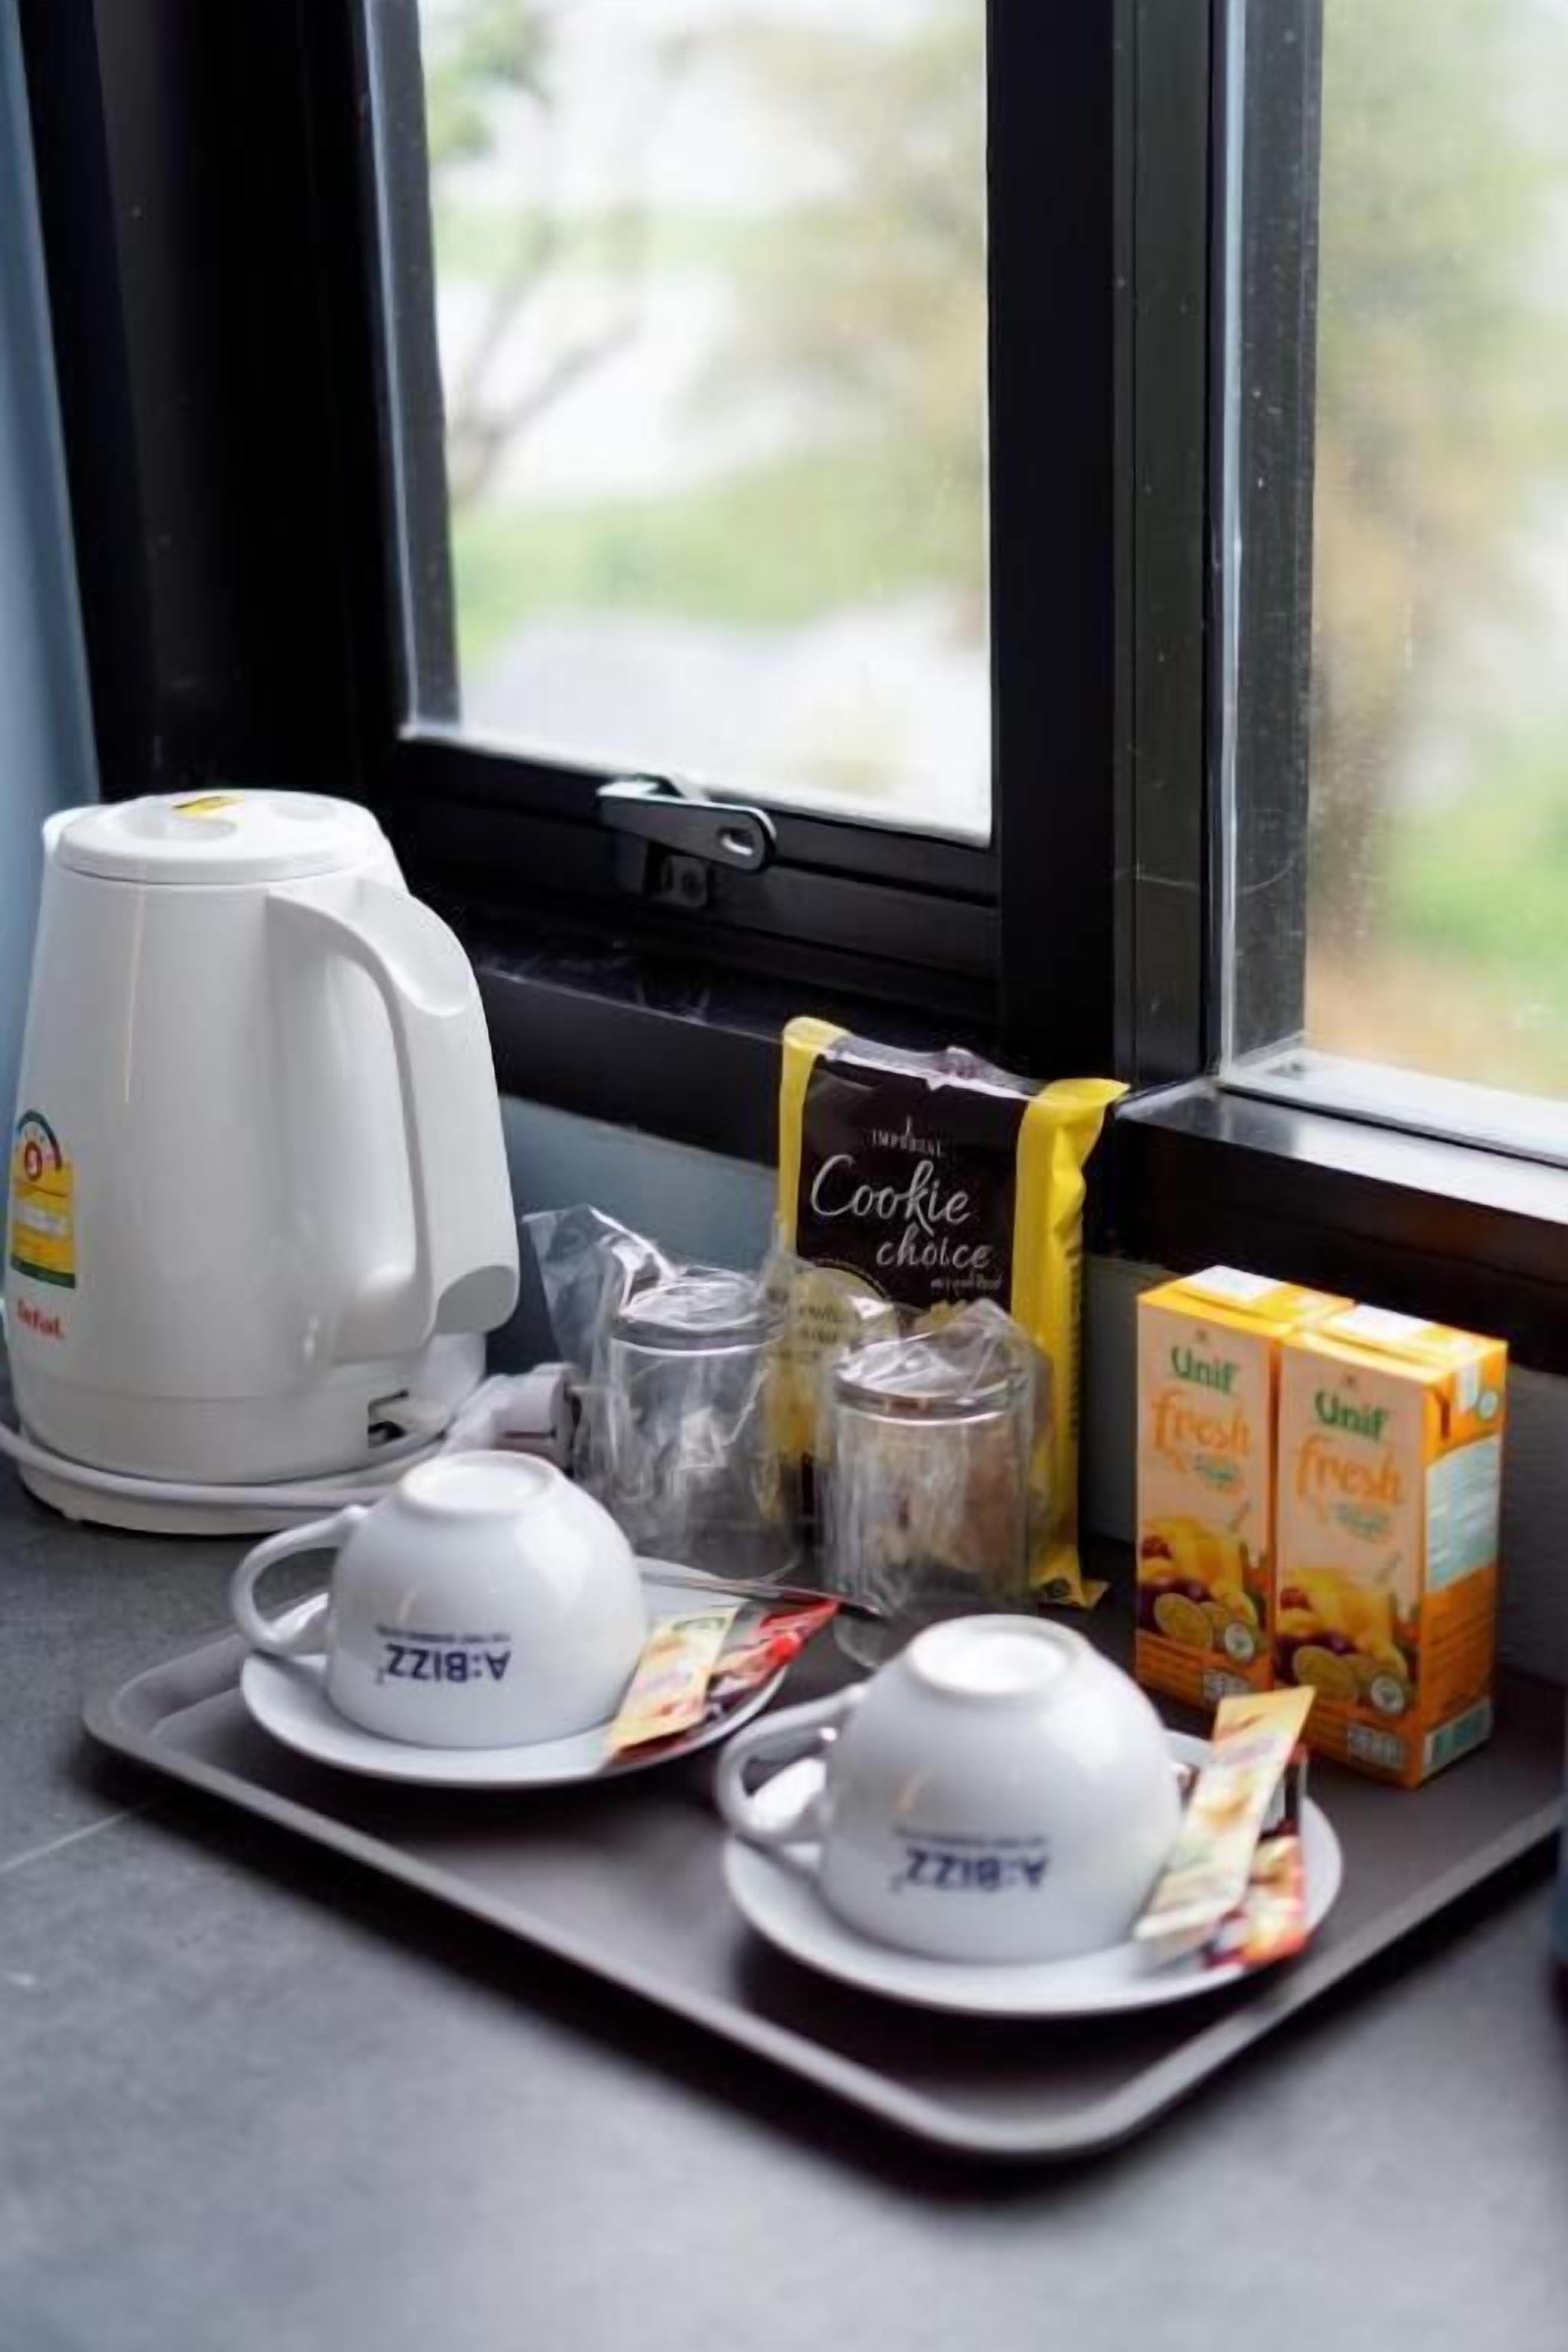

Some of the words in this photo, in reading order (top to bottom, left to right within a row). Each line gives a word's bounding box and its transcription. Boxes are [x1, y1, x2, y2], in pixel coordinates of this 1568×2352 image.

[809, 1153, 972, 1237] Cookie
[875, 1223, 993, 1268] choice
[1171, 1346, 1239, 1396] Unif
[1314, 1389, 1390, 1446] Unif
[385, 1643, 511, 1683] A:BIZZ
